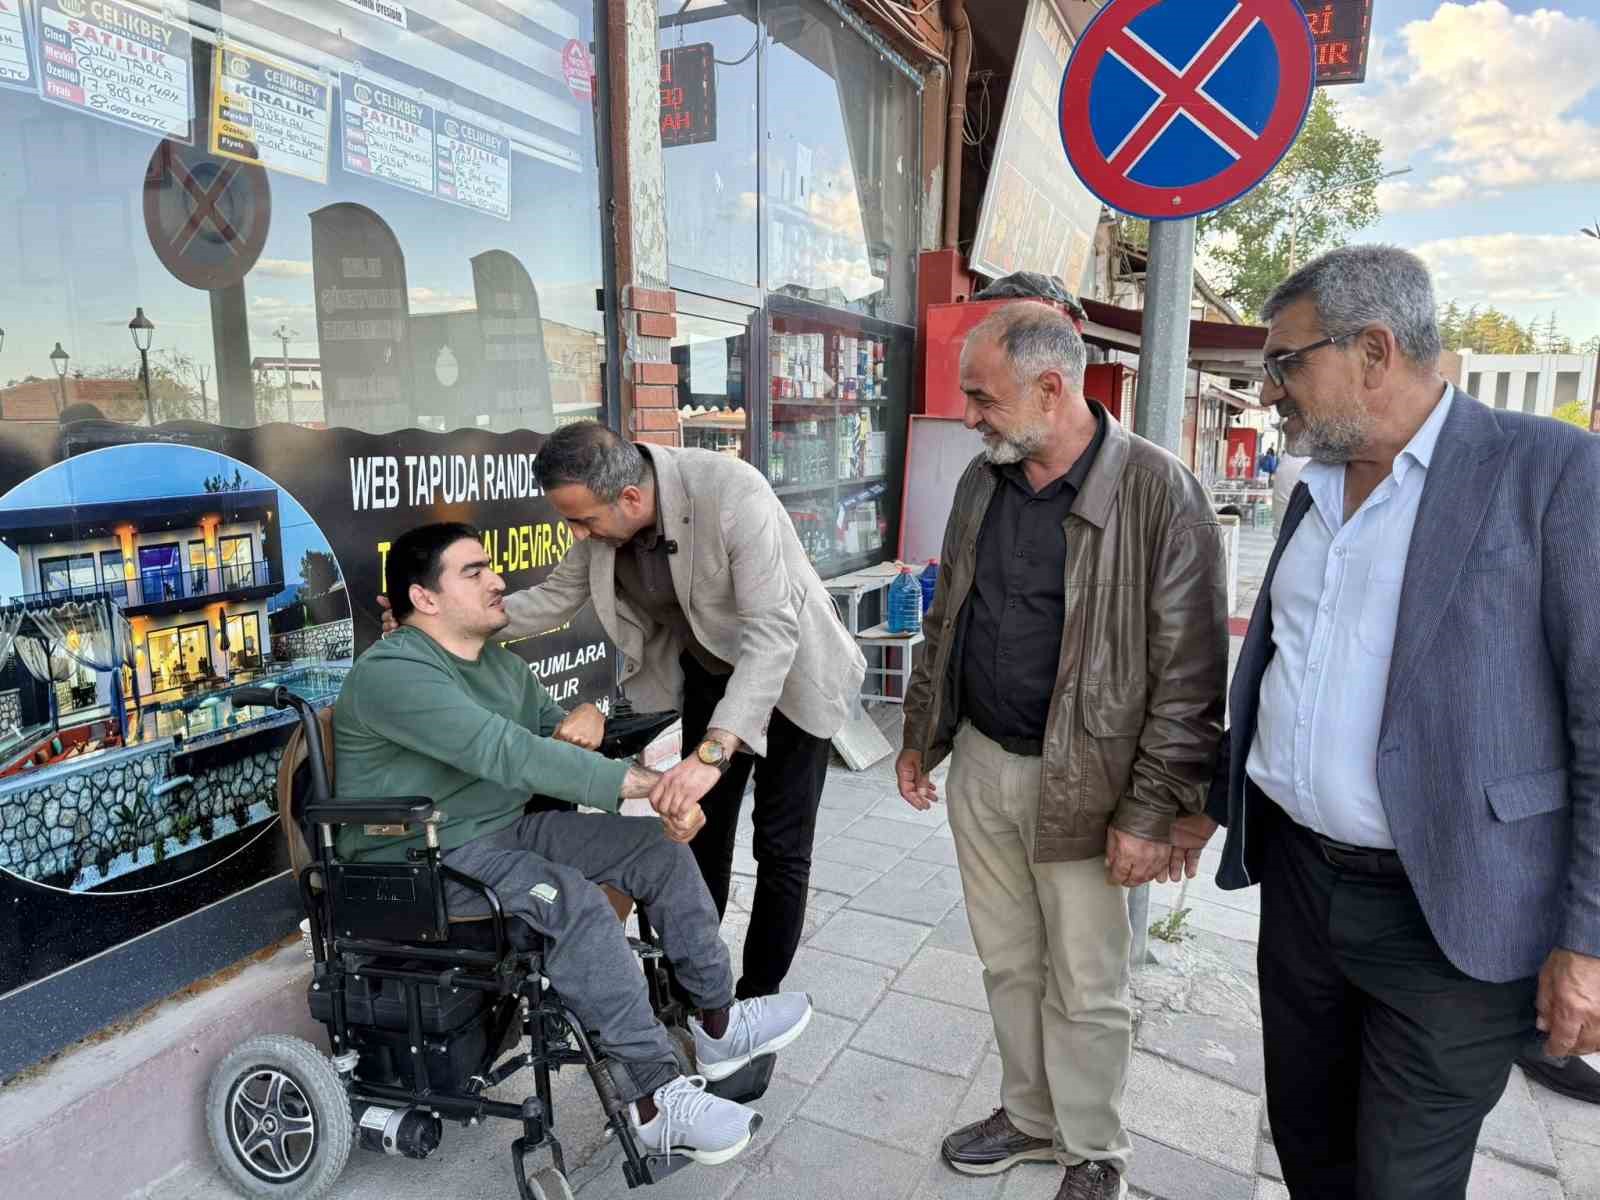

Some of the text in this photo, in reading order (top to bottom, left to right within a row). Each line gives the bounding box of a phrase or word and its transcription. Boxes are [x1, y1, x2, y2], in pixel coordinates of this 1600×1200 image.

[350, 456, 400, 511] WEB
[405, 454, 480, 507] TAPUDA
[529, 641, 606, 680] RUMLARA
